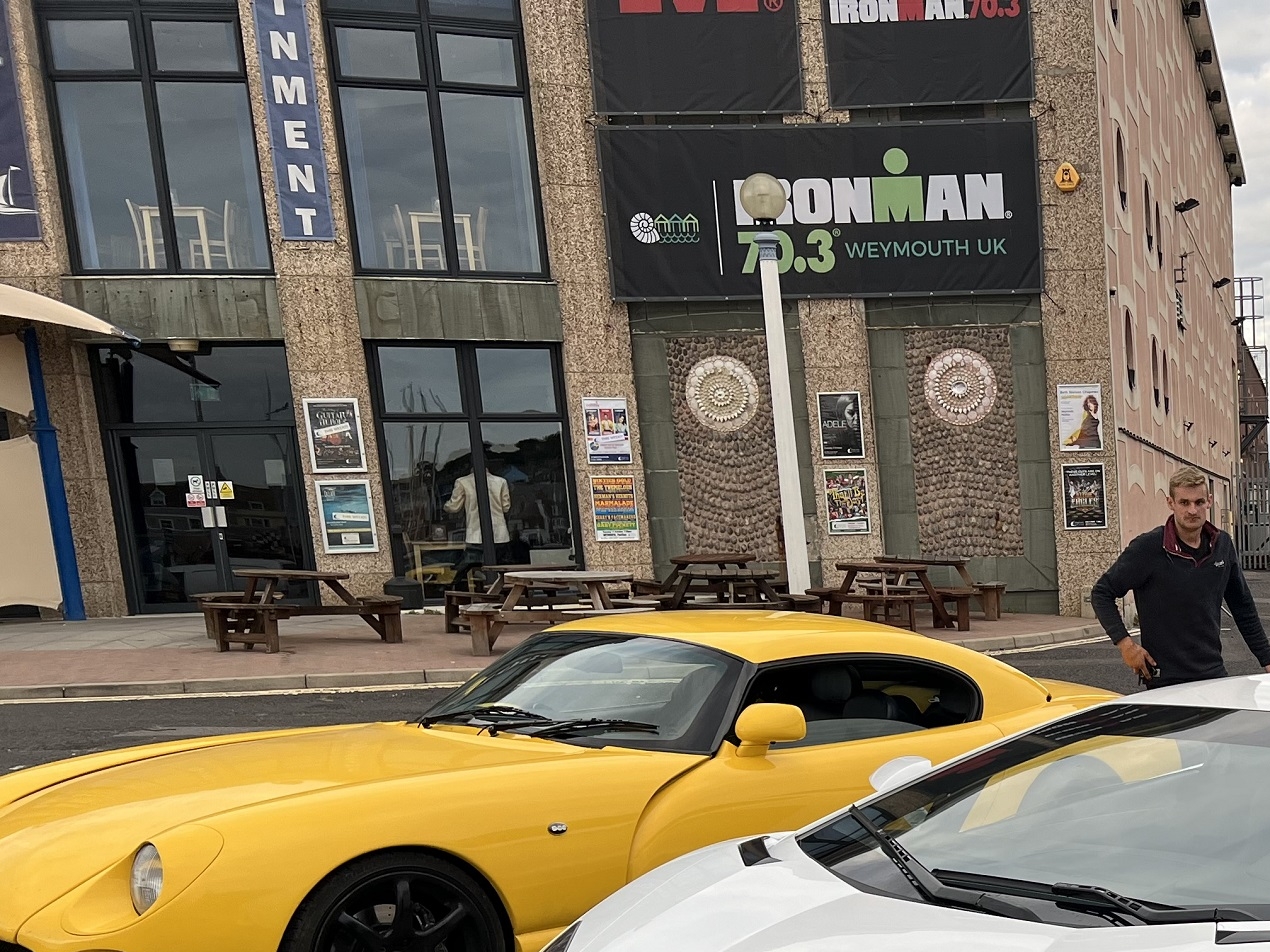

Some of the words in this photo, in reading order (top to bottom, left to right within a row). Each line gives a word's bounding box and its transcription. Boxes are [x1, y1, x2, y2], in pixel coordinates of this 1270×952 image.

[845, 240, 969, 258] WEYMOUTH
[978, 238, 1007, 256] UK
[823, 420, 847, 429] ADELE
